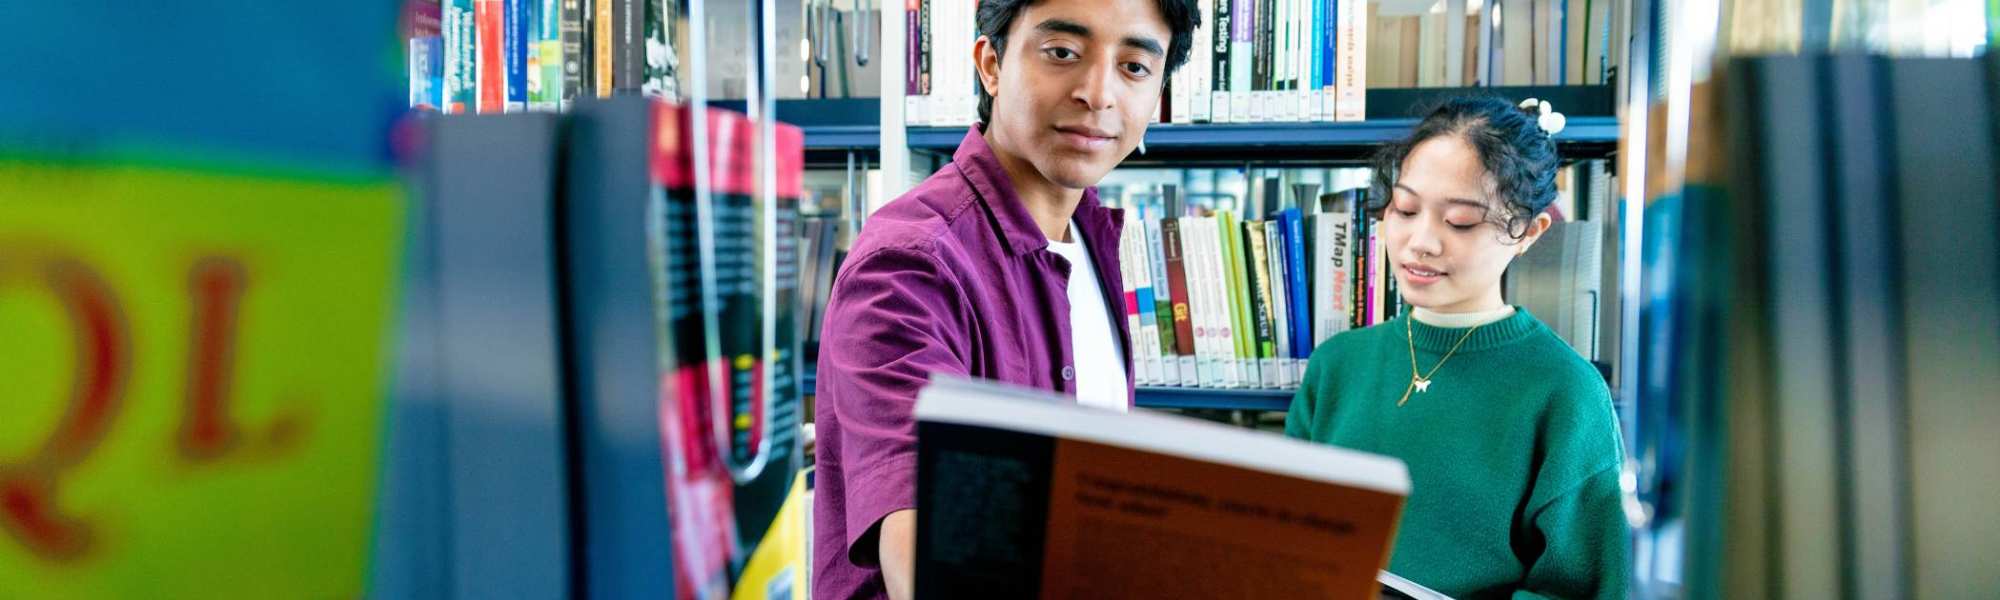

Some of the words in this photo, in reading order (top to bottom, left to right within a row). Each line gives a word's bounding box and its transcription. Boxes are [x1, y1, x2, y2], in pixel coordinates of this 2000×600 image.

[1216, 16, 1230, 53] Testing
[1331, 222, 1347, 268] TMap
[1333, 271, 1346, 311] Next
[1173, 302, 1188, 322] Git
